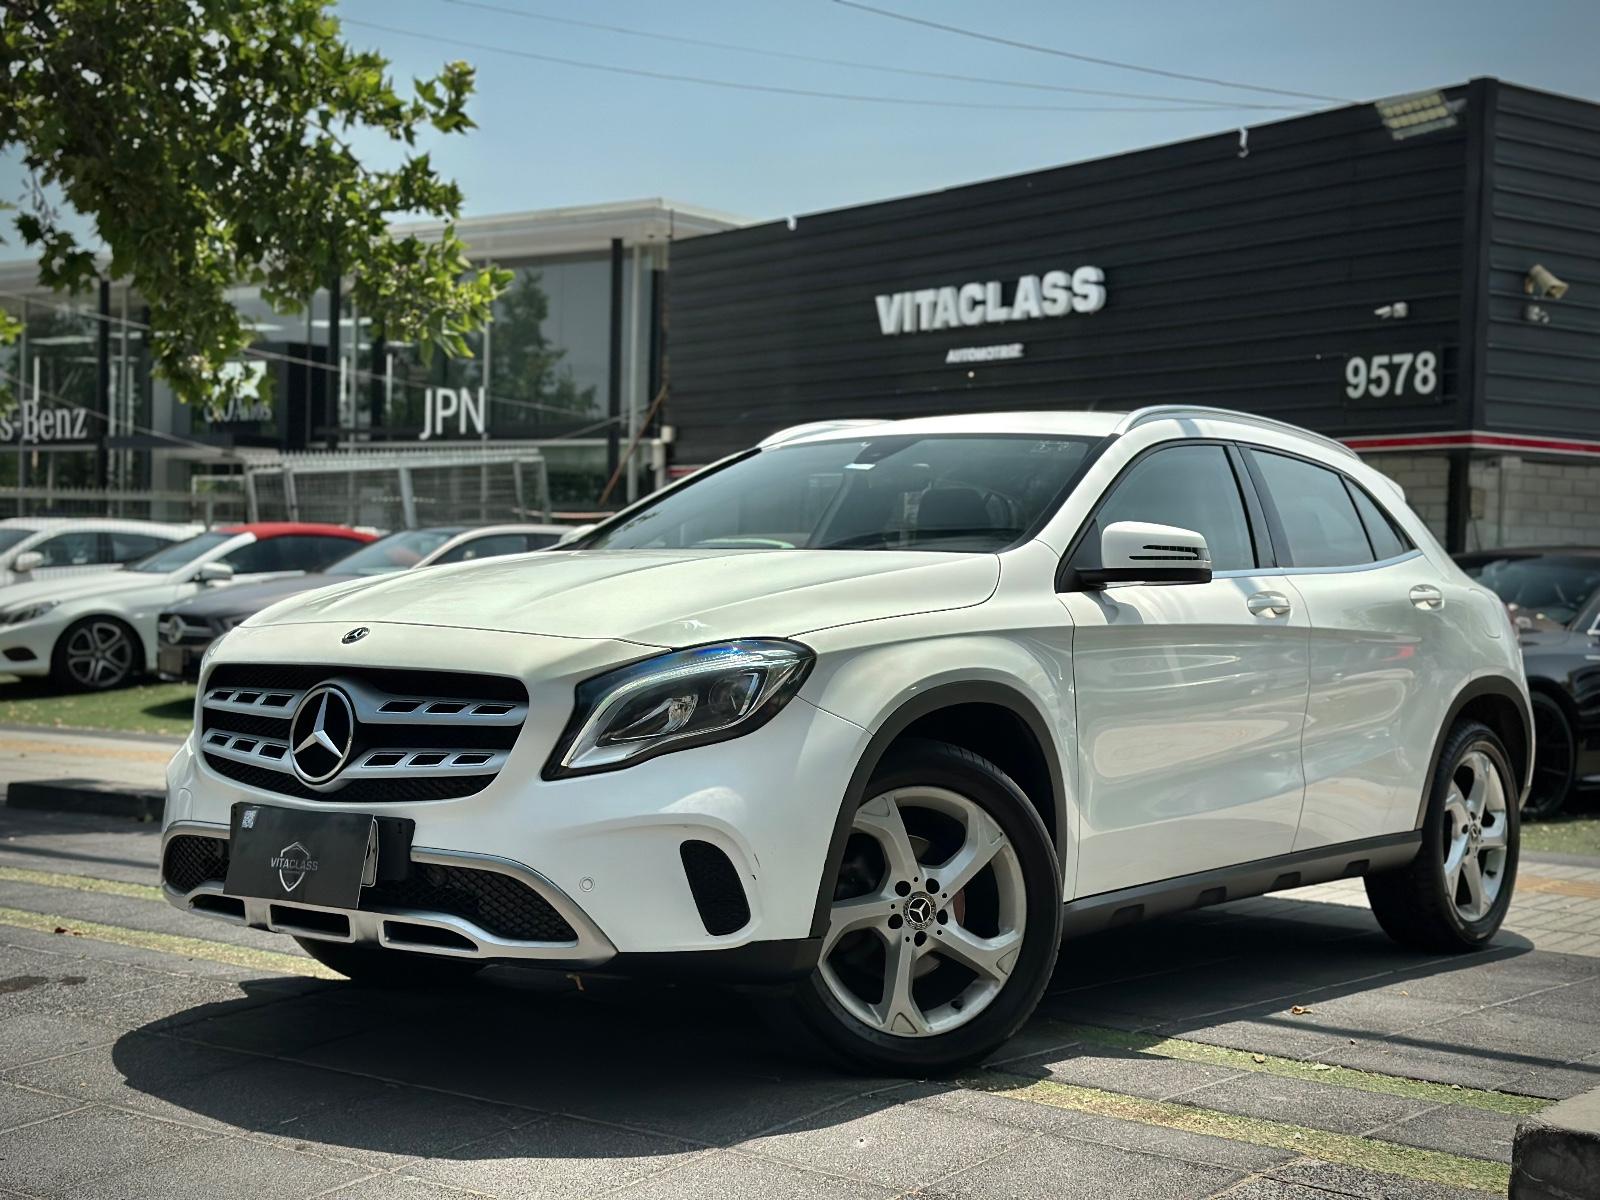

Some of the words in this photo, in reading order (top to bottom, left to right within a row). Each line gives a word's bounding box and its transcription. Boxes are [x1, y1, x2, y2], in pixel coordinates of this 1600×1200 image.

[875, 265, 1107, 335] VITACLASS
[1345, 351, 1437, 399] 9578
[418, 386, 485, 440] JPN
[270, 857, 319, 872] VITACLASS
